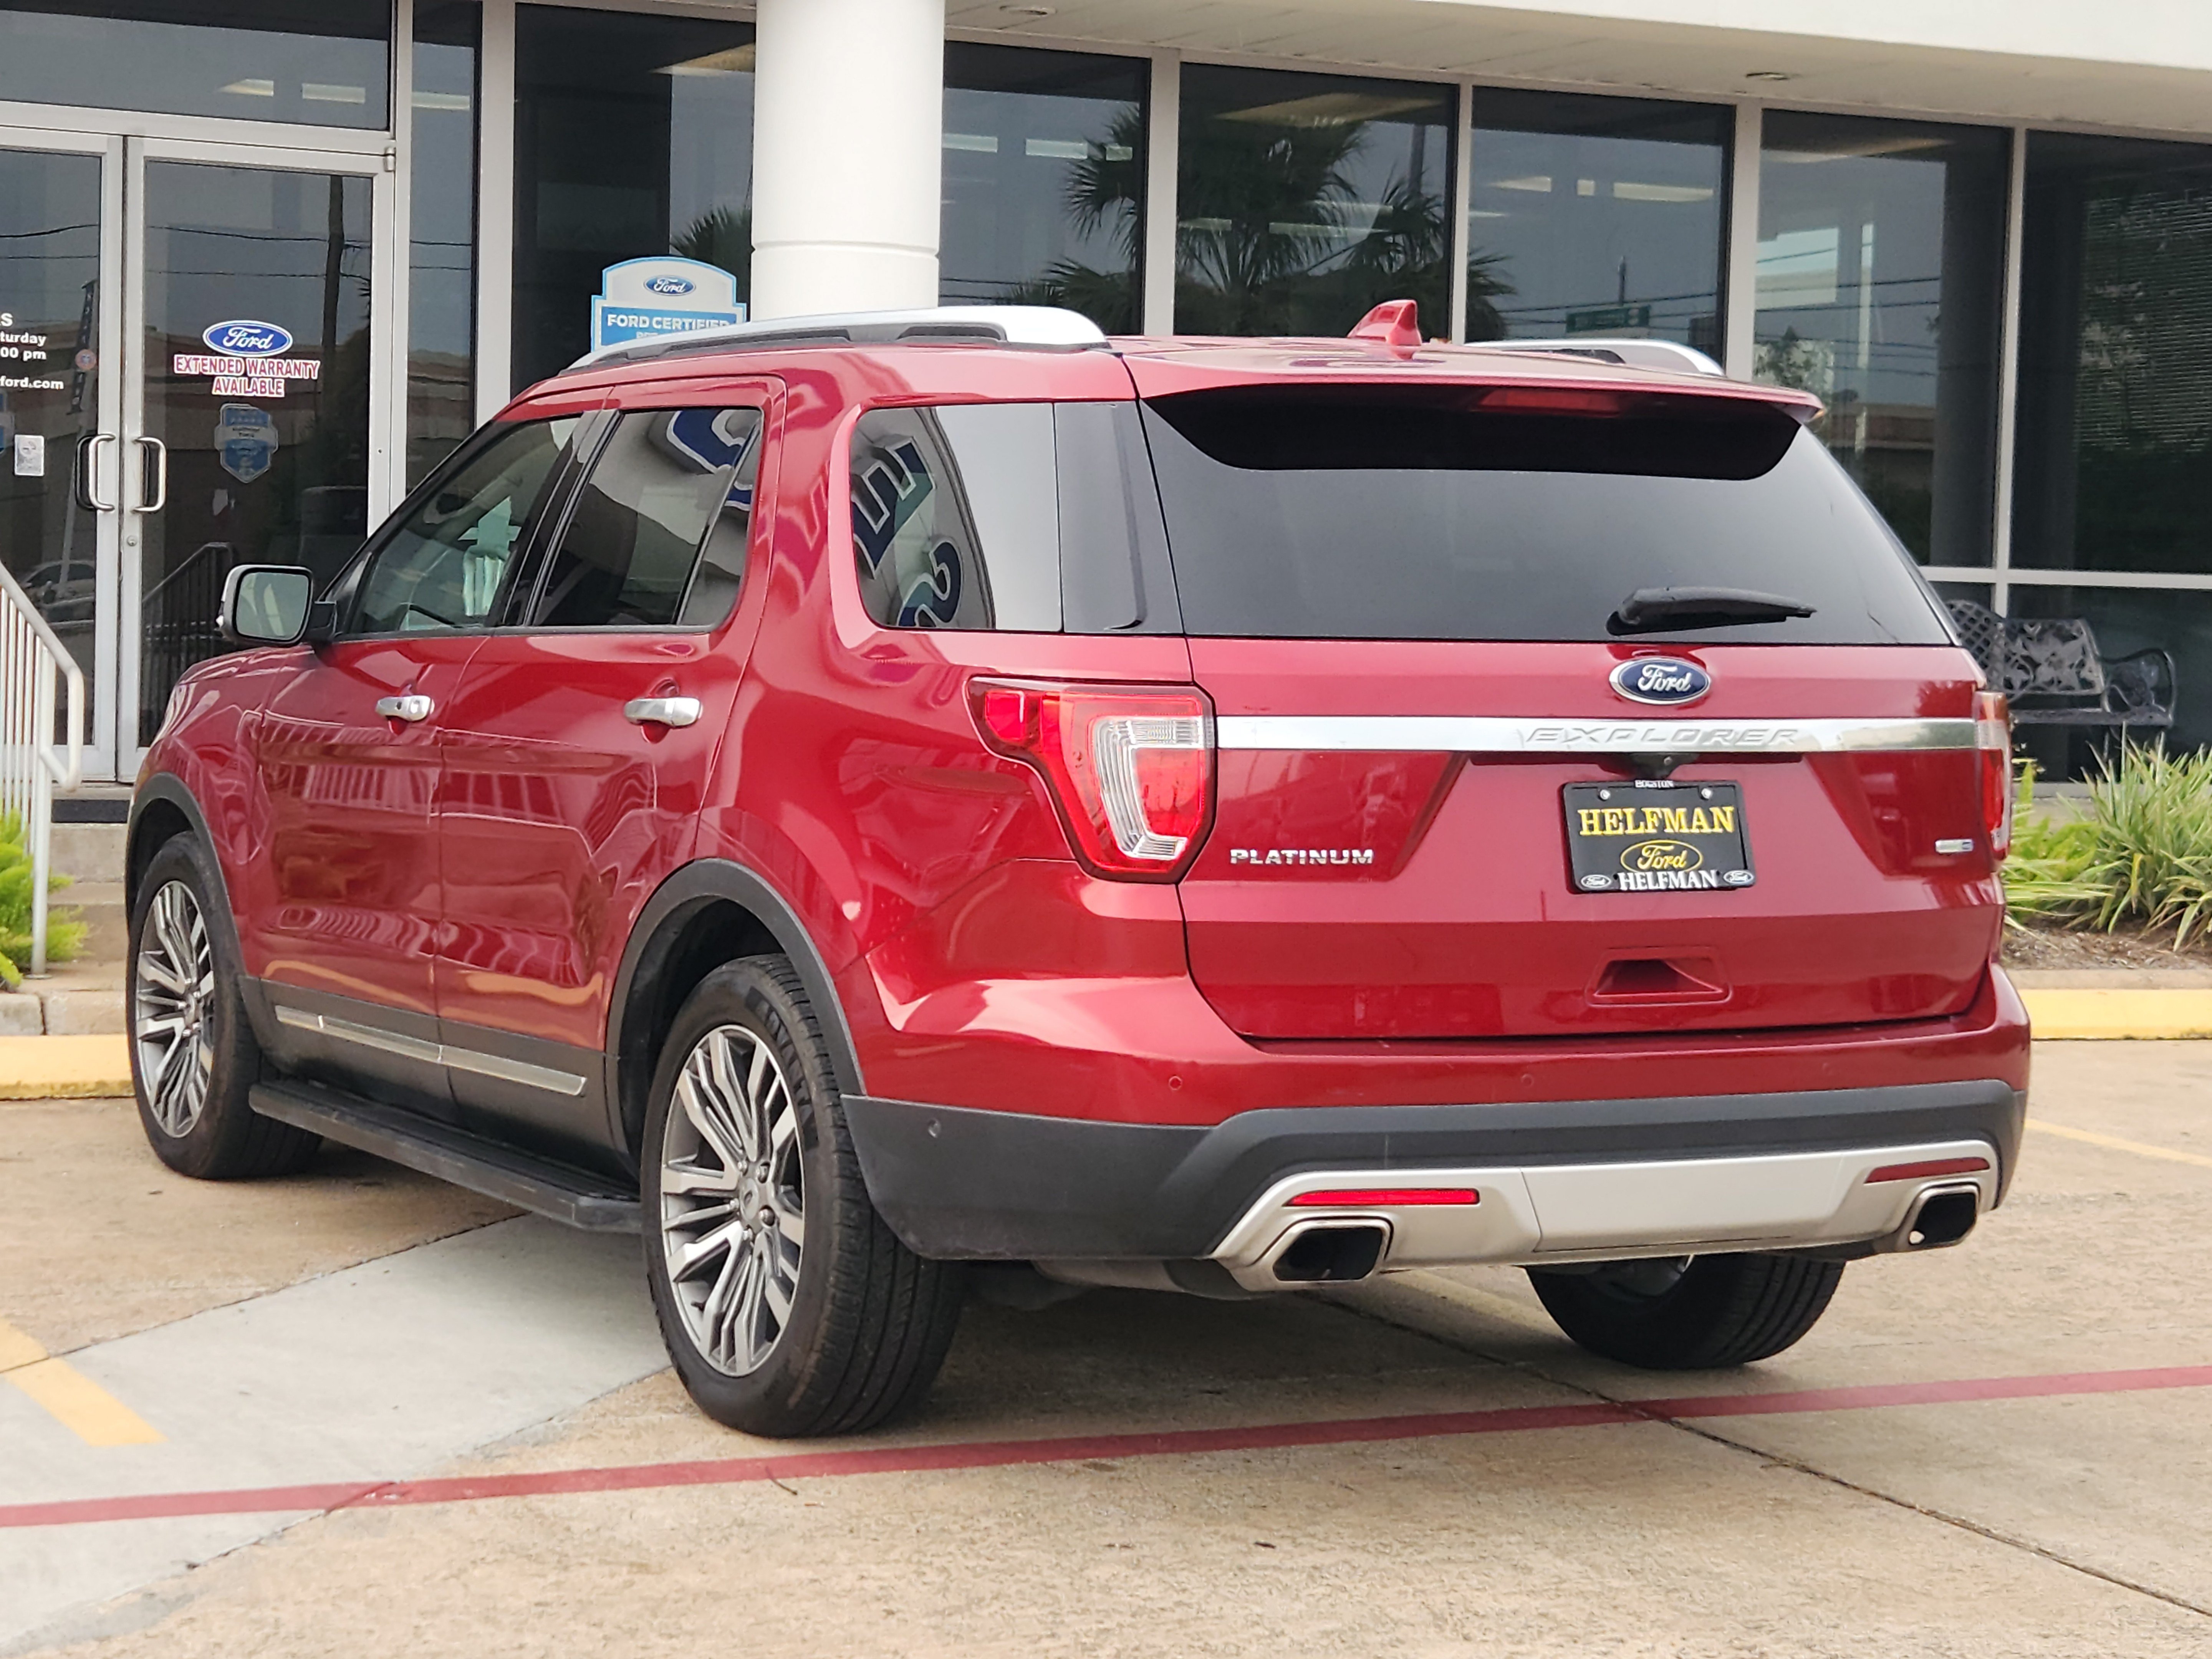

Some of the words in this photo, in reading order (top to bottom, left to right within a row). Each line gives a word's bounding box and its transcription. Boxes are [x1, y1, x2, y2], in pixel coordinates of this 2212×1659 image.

[654, 278, 687, 293] Ford
[0, 313, 13, 326] S
[608, 314, 650, 328] FORD
[0, 331, 47, 346] turday
[222, 326, 275, 349] Ford
[23, 350, 46, 361] pm
[176, 356, 243, 374] EXTENDED
[247, 358, 319, 378] WARRANTY
[0, 376, 64, 389] ford.com
[214, 378, 284, 395] AVAILABLE
[1637, 664, 1692, 692] Ford
[1525, 727, 1799, 746] EXPLORER
[1577, 806, 1734, 835] HELFMAN
[1230, 849, 1373, 864] PLATINUM
[1637, 845, 1688, 870] Ford
[1618, 870, 1719, 890] HELFMAN
